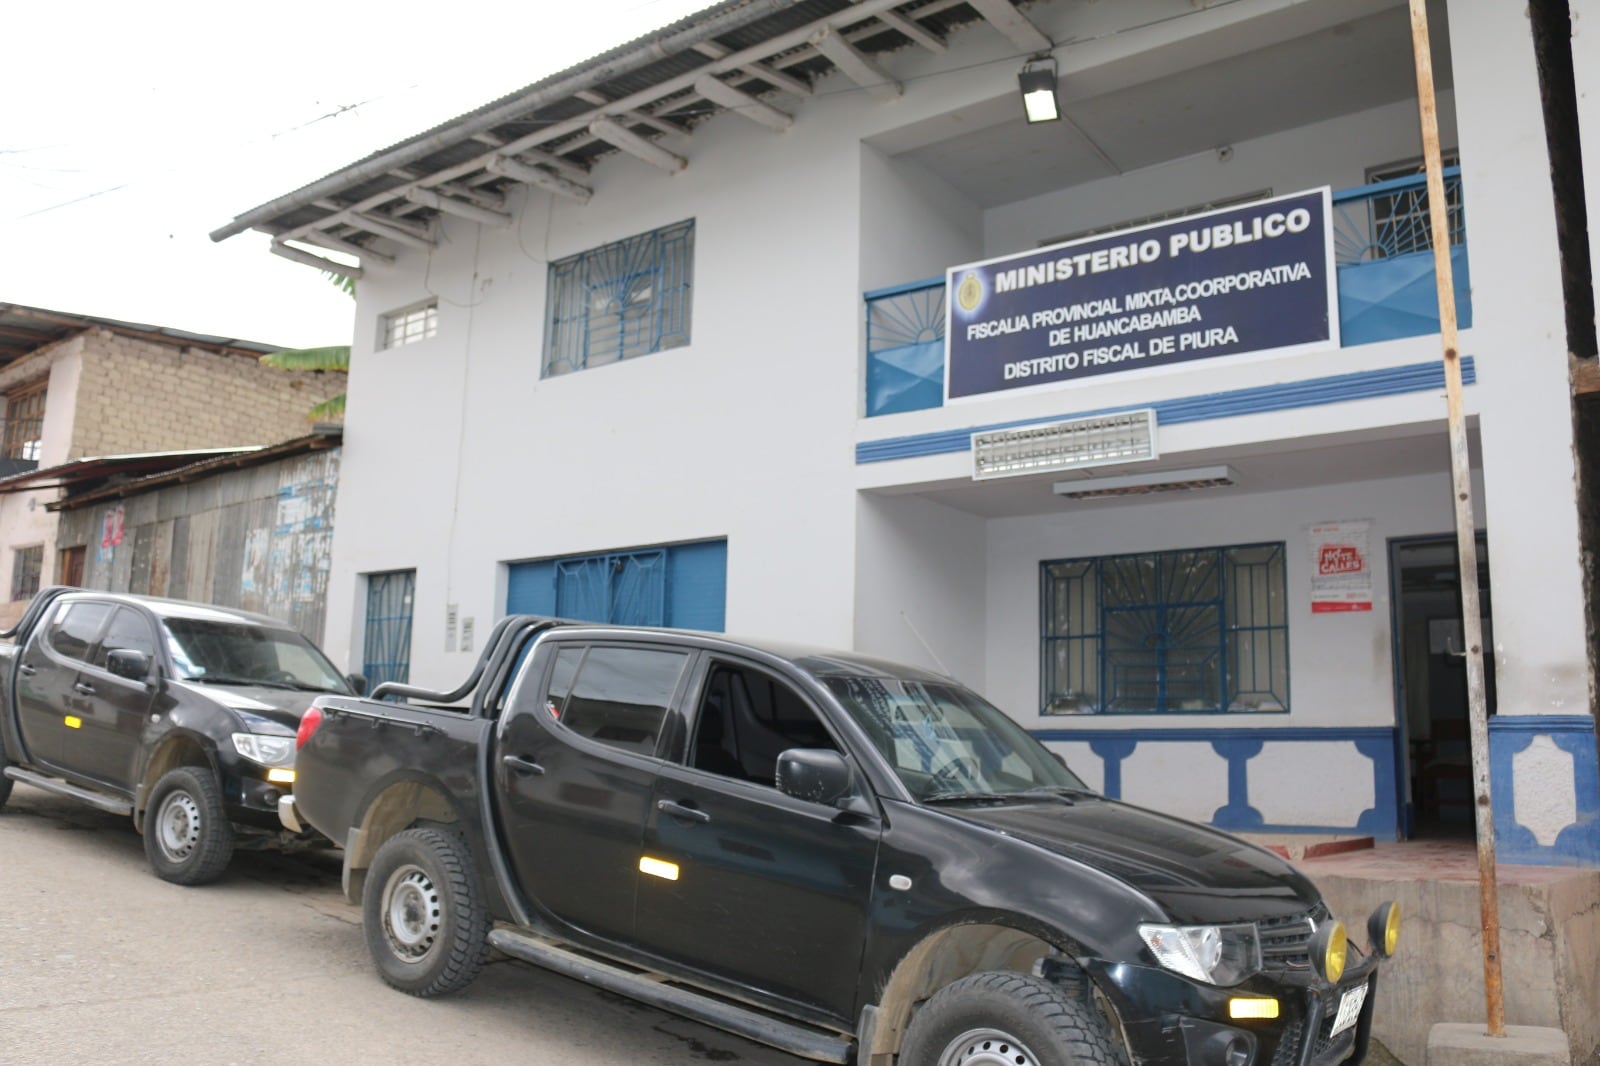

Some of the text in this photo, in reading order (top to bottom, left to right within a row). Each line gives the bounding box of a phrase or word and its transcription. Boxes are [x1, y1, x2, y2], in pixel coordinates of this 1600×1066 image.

[994, 208, 1311, 294] MINISTERIO PUBLICO
[966, 315, 1030, 341] FISCALIA
[1032, 297, 1122, 329] PROVINCIAL
[1048, 304, 1202, 347] DE HUANCABAMBA
[1004, 326, 1239, 380] DISTRITO FISCAL DE PIURA
